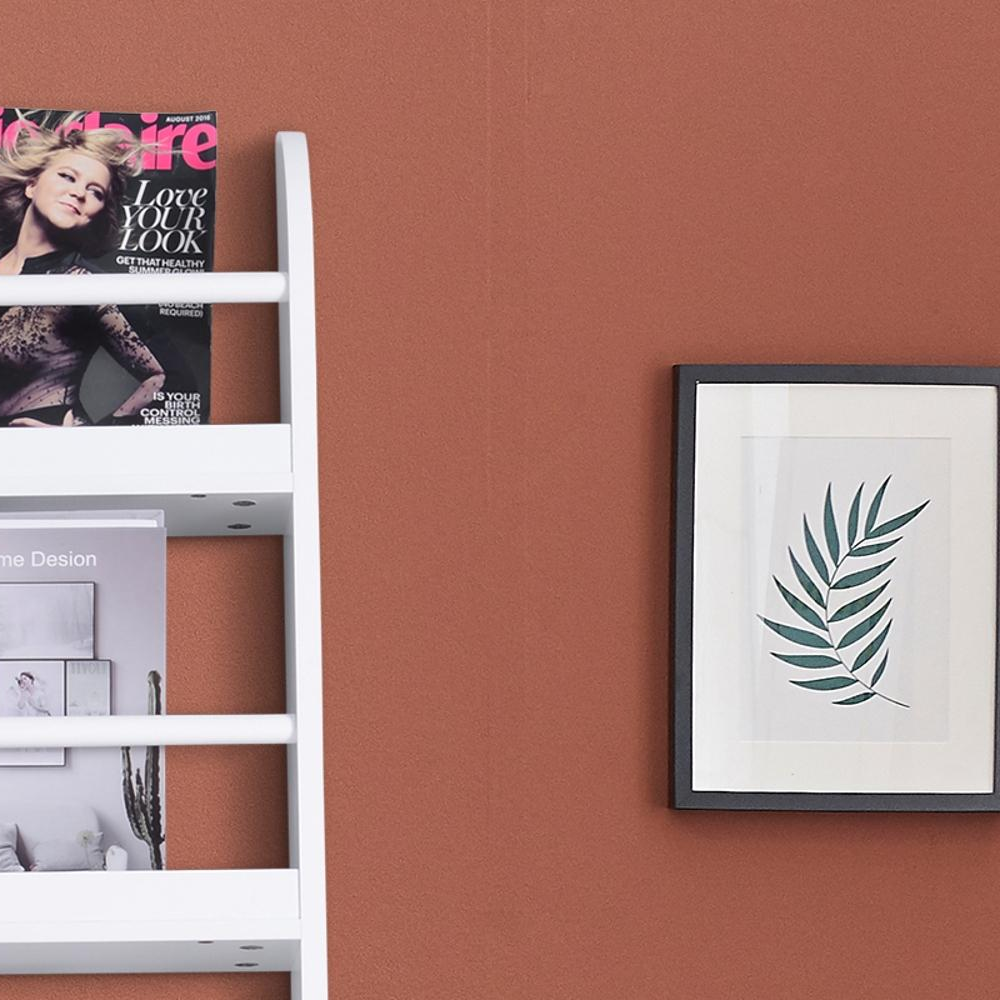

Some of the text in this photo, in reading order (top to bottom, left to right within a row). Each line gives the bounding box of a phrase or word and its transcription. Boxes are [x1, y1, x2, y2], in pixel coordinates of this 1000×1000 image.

[166, 115, 194, 123] AUGUST
[55, 111, 217, 171] ire
[134, 179, 209, 208] Love
[121, 205, 206, 230] YOUR
[118, 228, 208, 254] LOOK
[116, 255, 205, 269] GET THAT HEALTHY
[153, 391, 200, 401] IS YOUR
[164, 401, 200, 409] BIRTH
[140, 408, 200, 417] CONTROL
[144, 416, 200, 425] MESSING
